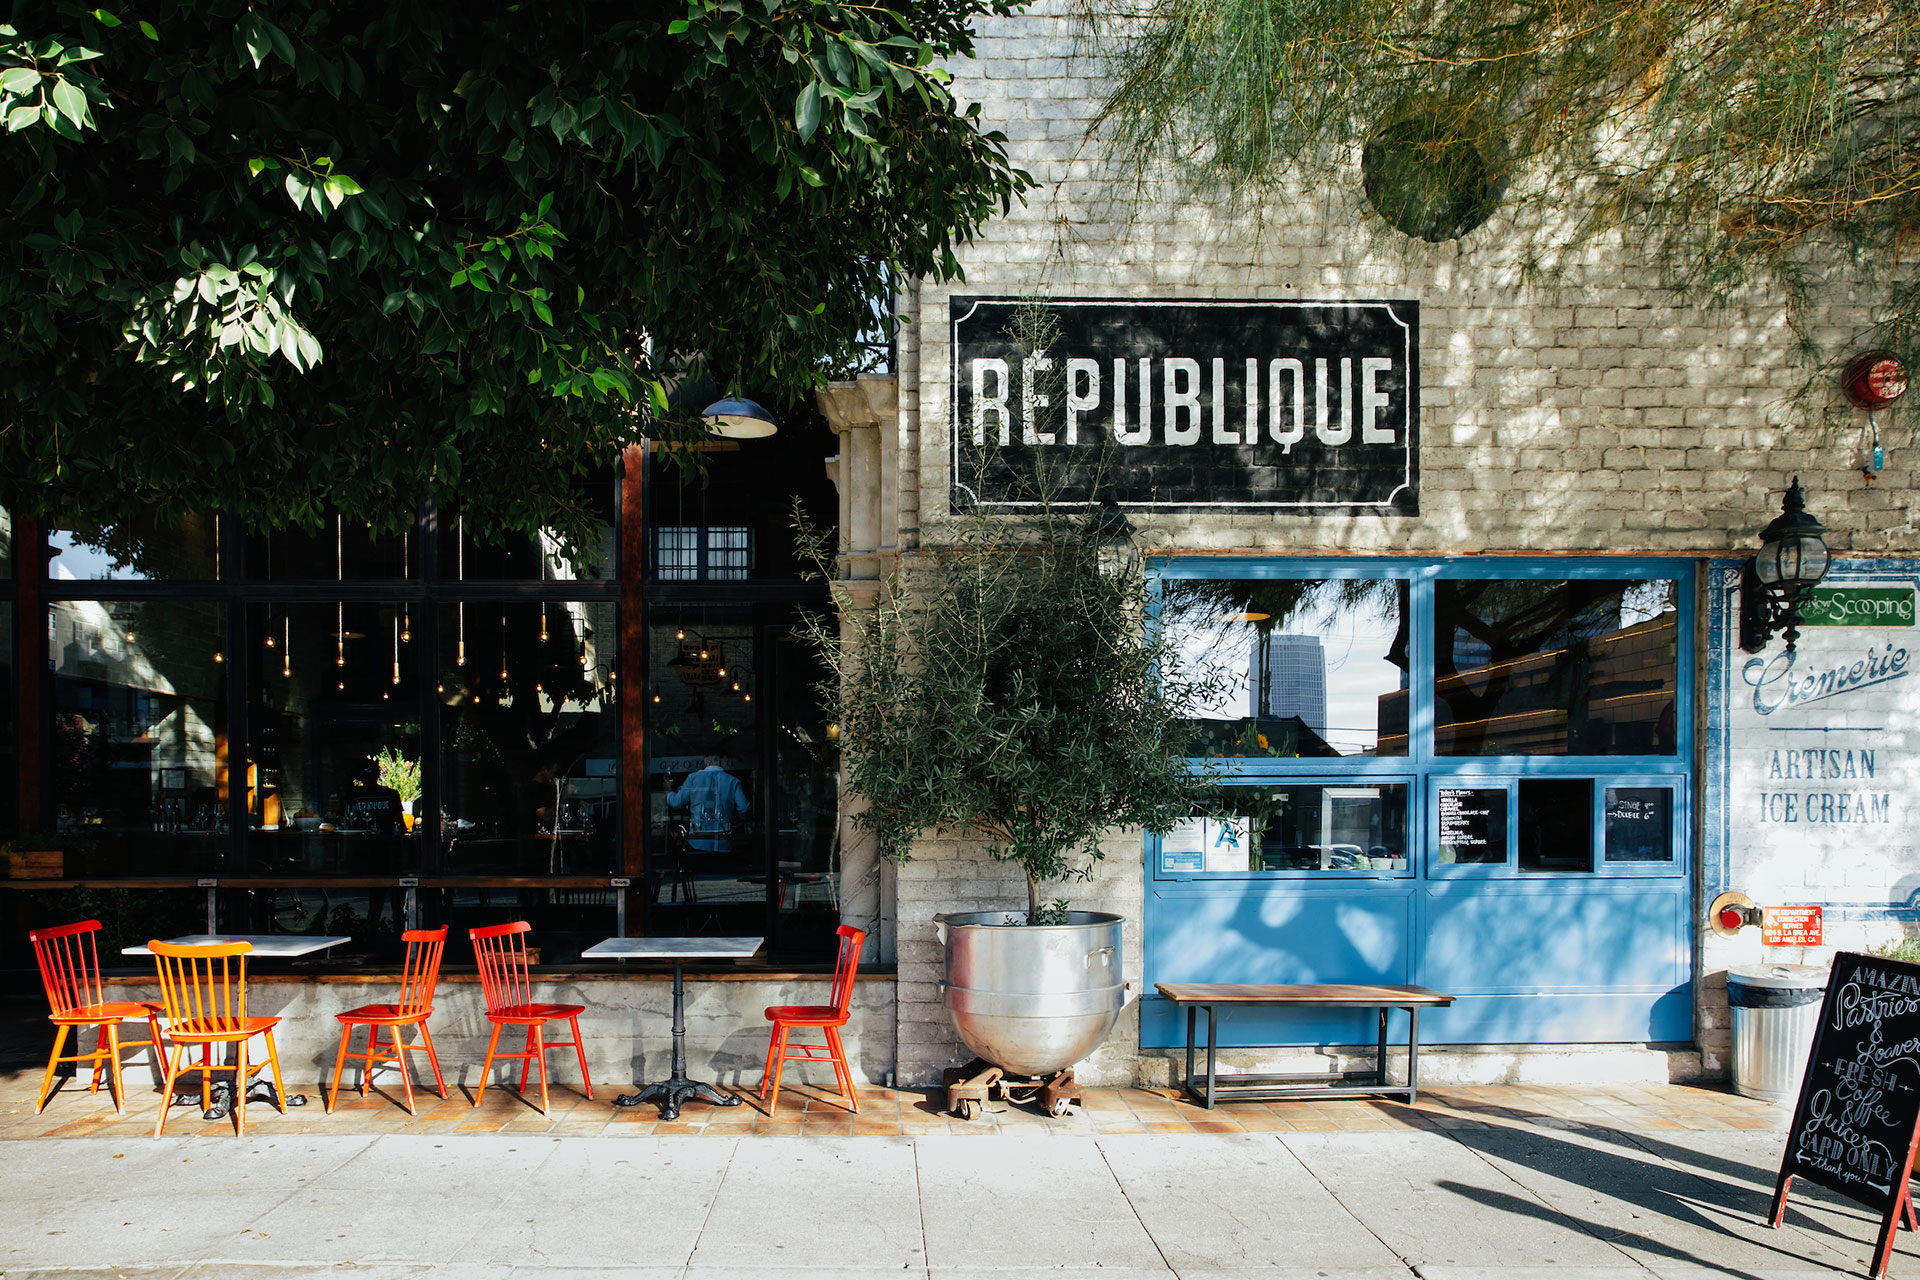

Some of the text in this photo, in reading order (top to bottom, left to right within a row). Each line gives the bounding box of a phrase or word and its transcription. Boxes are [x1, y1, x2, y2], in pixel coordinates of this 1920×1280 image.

[1829, 592, 1913, 620] Scooping
[1769, 749, 1876, 780] ARTISAN
[1760, 792, 1890, 823] ICE CREAM
[1849, 965, 1920, 997] AMAZIN
[1832, 982, 1920, 1031] Pastries
[1870, 1019, 1883, 1044] &
[1834, 1058, 1898, 1092] FRESH
[1836, 1075, 1901, 1128] Coffee
[1841, 1100, 1854, 1125] &
[1805, 1088, 1871, 1152] Juices
[1799, 1130, 1899, 1181] CARD ONLY
[1810, 1155, 1869, 1184] thank you!
